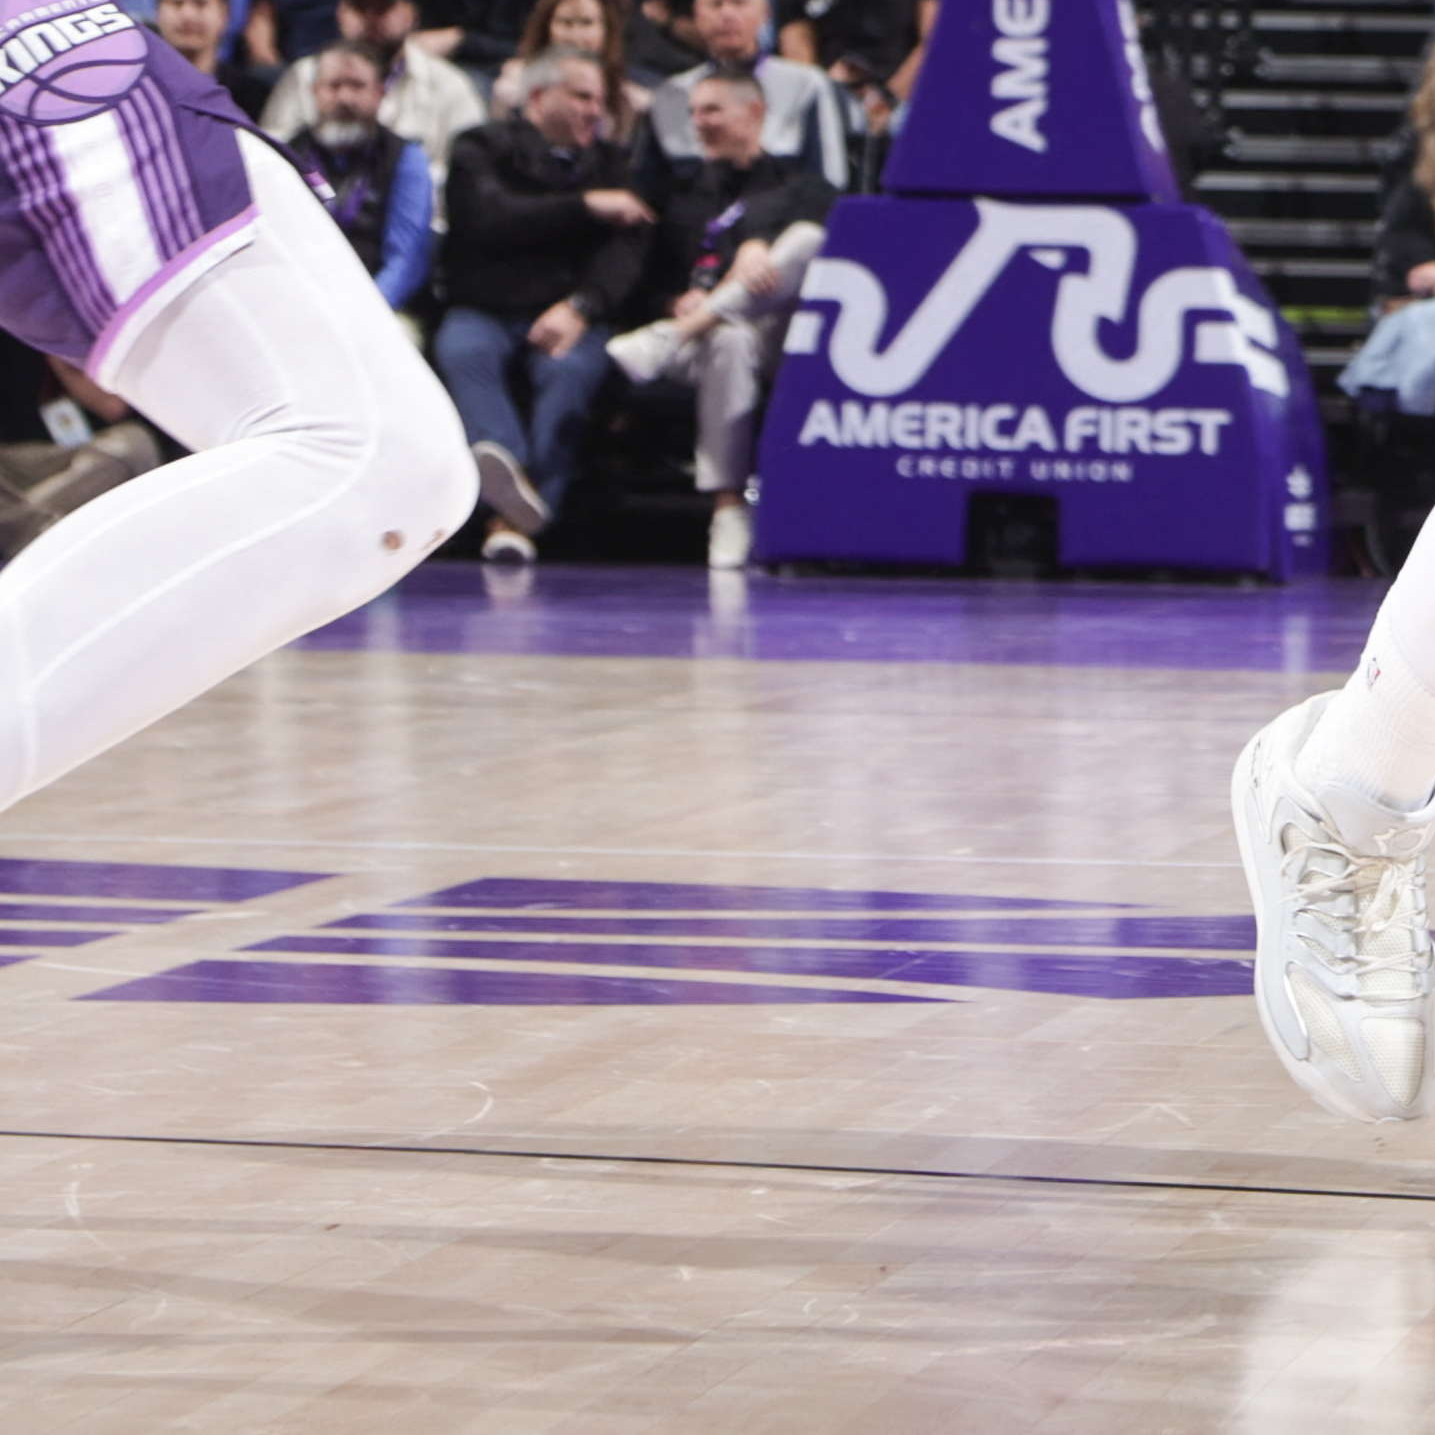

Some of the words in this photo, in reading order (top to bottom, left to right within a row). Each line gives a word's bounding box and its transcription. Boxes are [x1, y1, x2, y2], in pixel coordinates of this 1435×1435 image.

[799, 399, 1058, 452] AMERICA
[1063, 406, 1233, 456] FIRST
[895, 455, 1016, 479] CREDIT
[1029, 458, 1134, 483] UNION
